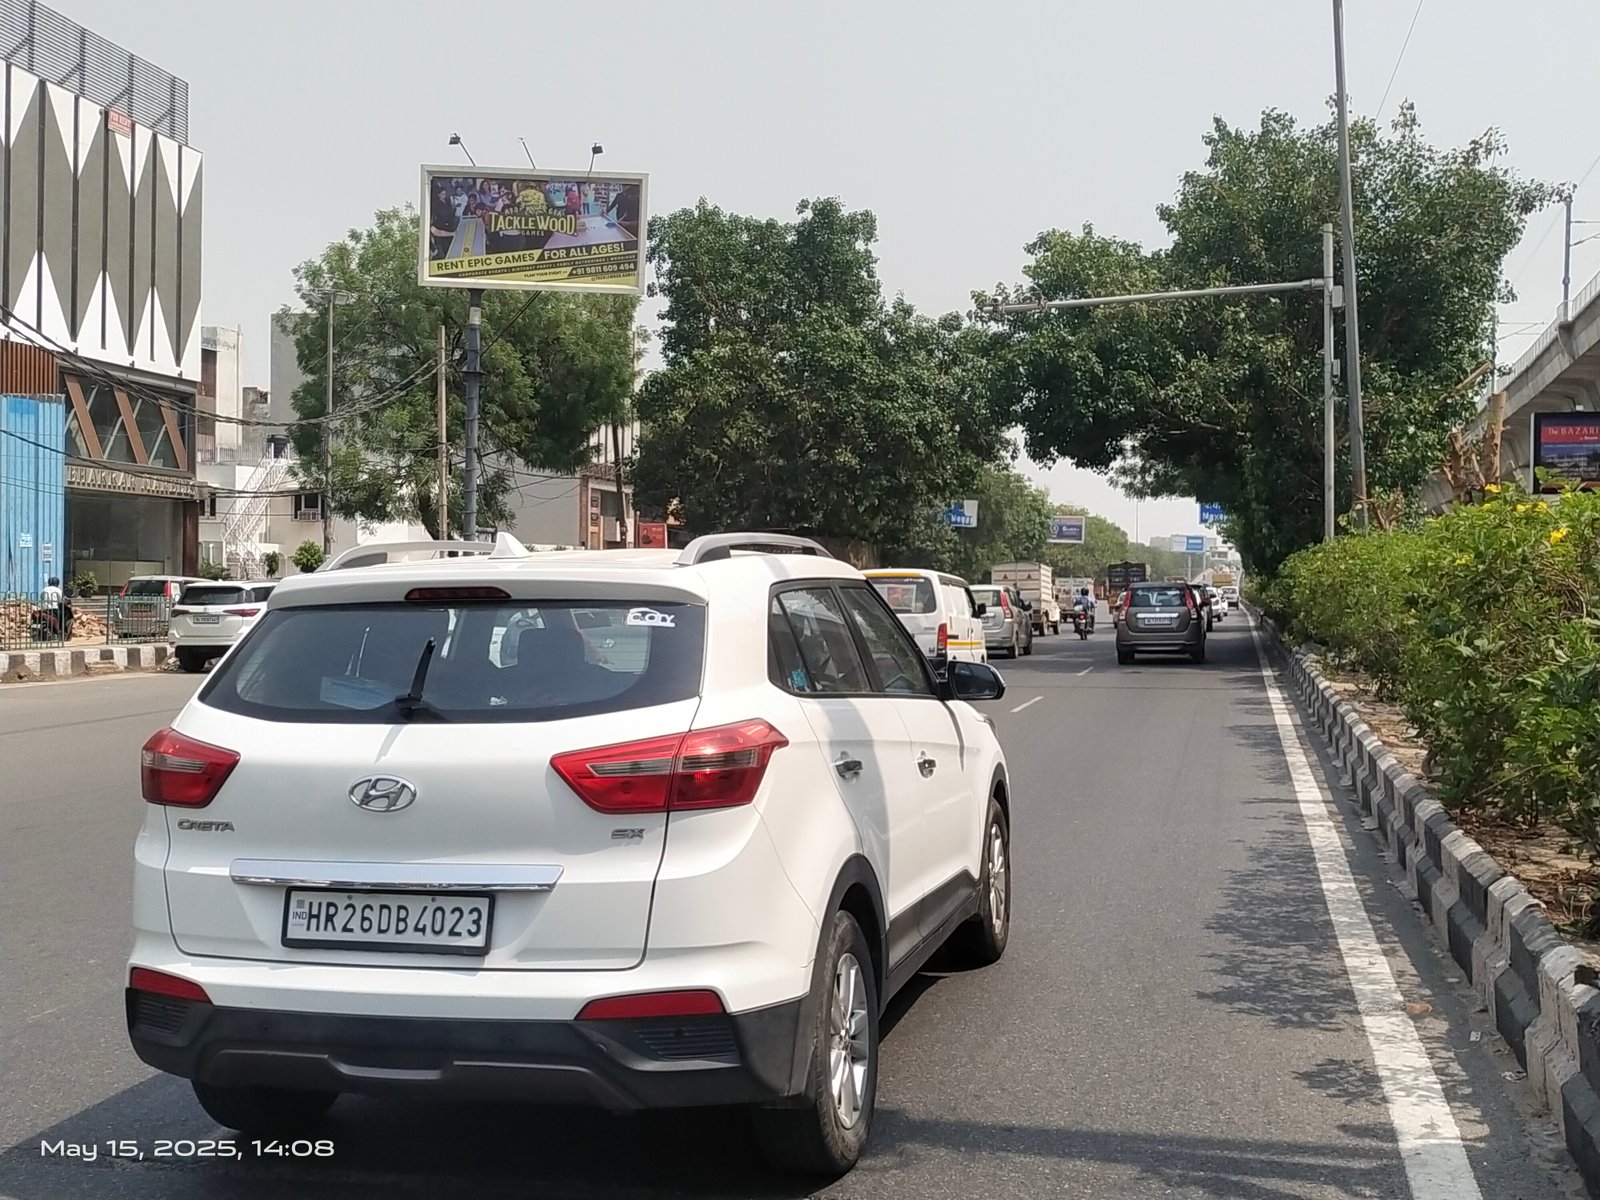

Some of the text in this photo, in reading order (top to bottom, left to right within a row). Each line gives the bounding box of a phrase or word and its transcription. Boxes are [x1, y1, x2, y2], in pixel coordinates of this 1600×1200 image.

[488, 211, 576, 235] TACKLEWOOD
[436, 242, 625, 271] RENT EPIC GAMES FOR ALL AGES!
[571, 262, 635, 275] +91 9811 609 494
[177, 818, 235, 832] CRETA
[292, 900, 482, 937] IND HR26DB4023
